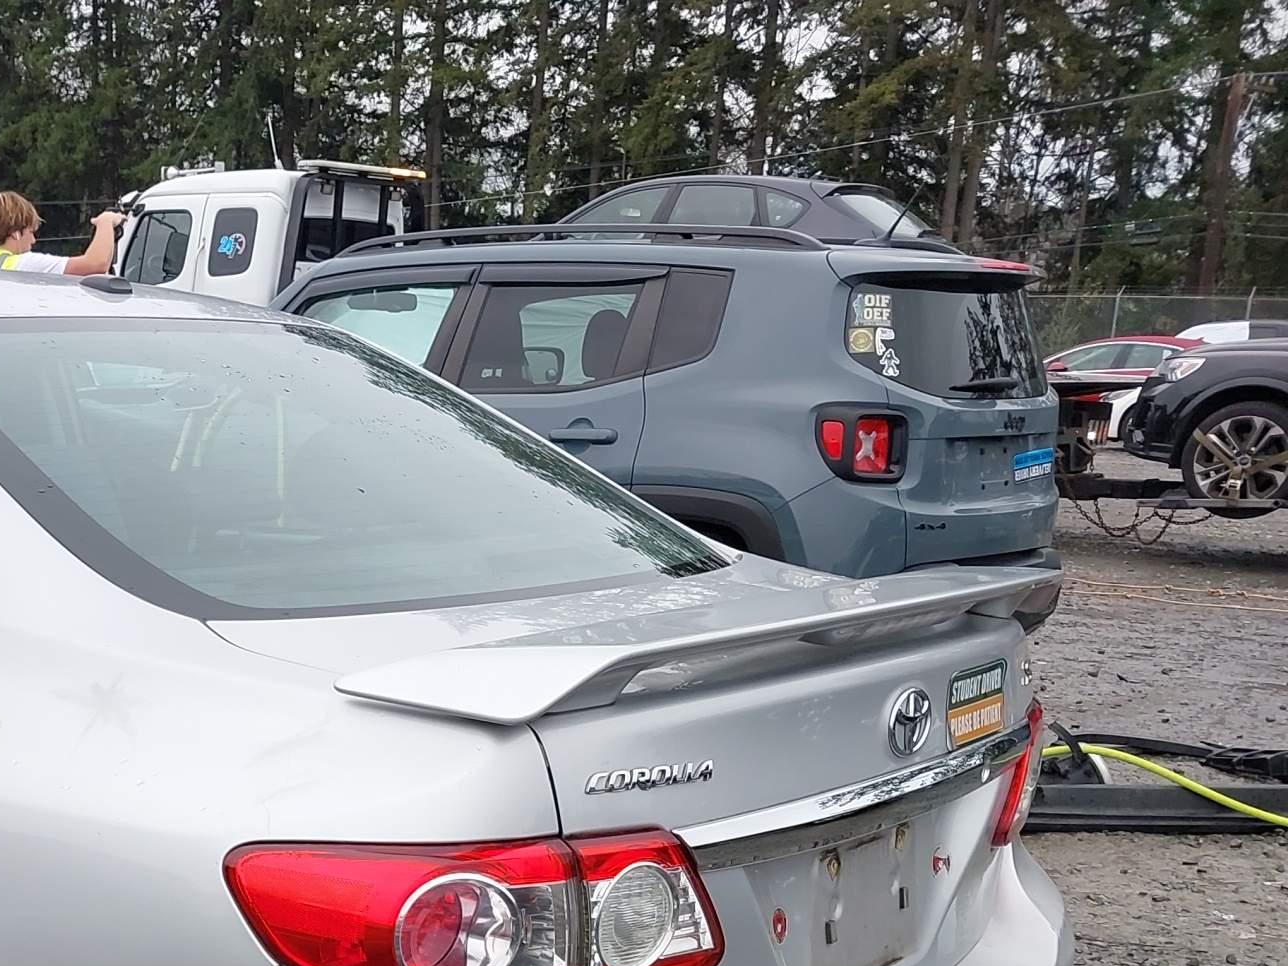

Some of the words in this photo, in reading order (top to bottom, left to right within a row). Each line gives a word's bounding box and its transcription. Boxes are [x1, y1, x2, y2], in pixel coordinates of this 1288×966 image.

[864, 294, 891, 307] OIF
[864, 307, 891, 320] OEF
[951, 674, 982, 704] STUDENT
[981, 668, 1002, 694] DRIVER
[951, 711, 972, 737] PLEASE
[972, 709, 981, 730] BE
[980, 702, 1001, 729] PATIENT
[584, 759, 714, 795] COROLLA
